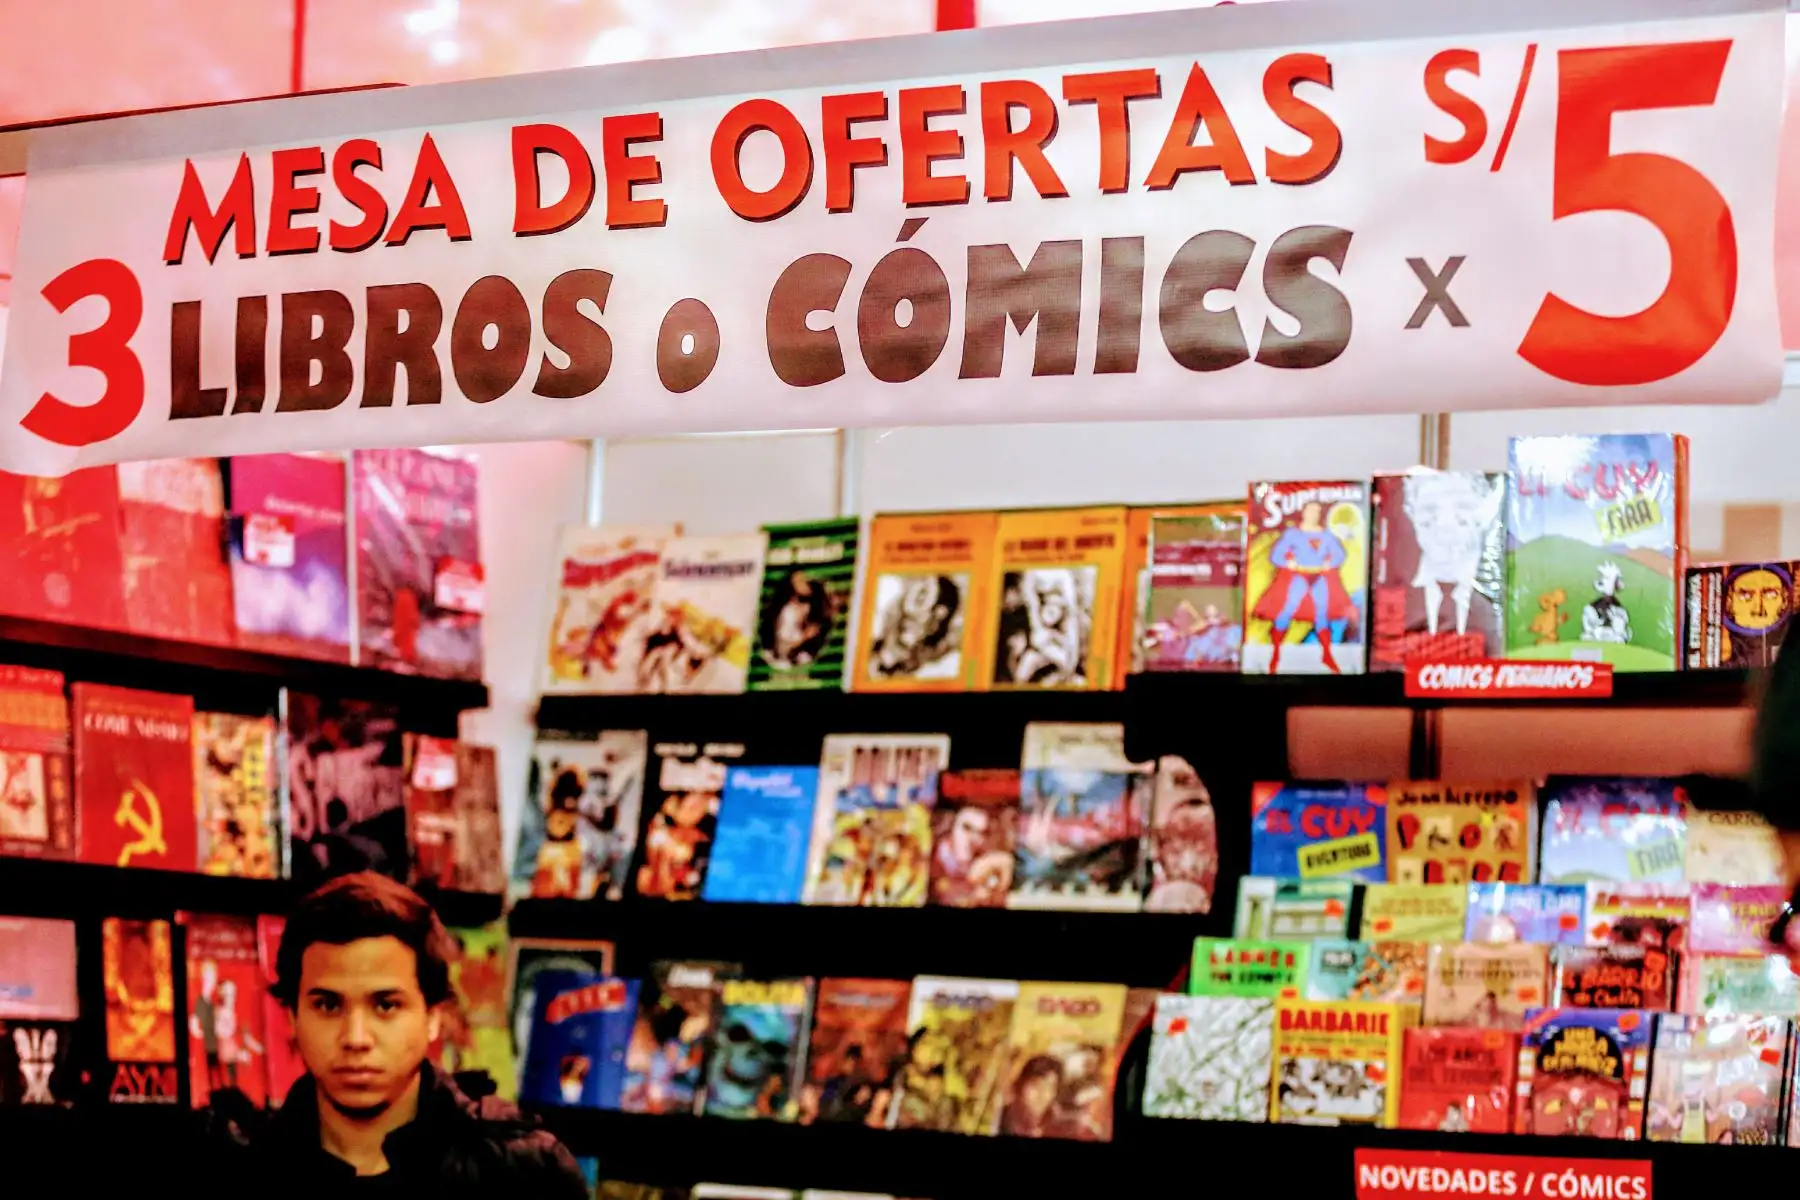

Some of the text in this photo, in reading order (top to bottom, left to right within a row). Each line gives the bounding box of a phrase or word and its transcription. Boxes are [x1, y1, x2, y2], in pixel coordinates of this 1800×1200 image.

[163, 53, 1342, 266] MESA DE OFERTAS
[20, 258, 146, 447] 3
[168, 269, 614, 421] LIBROS
[766, 217, 1354, 388] CÓMICS
[1301, 804, 1377, 839] CUY
[1280, 1007, 1389, 1036] BARBARIE
[1358, 1164, 1648, 1200] NOVEDADES / CÓMICS
